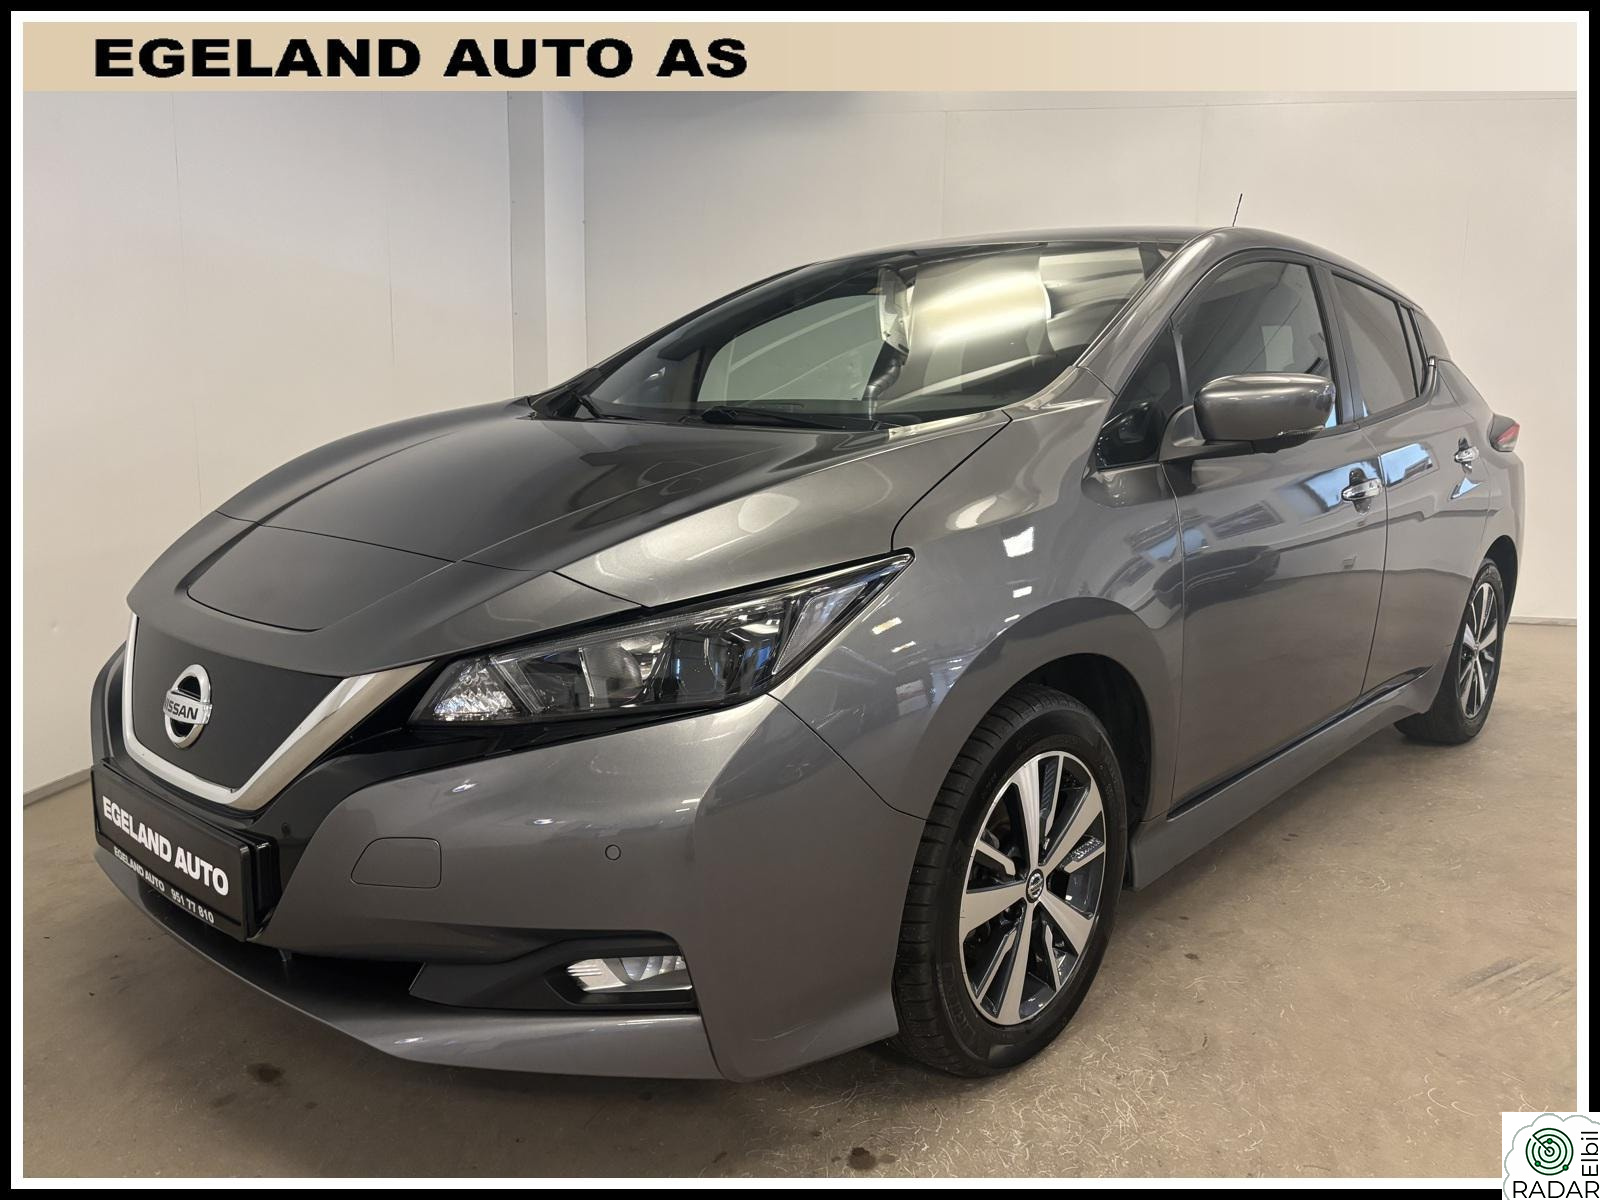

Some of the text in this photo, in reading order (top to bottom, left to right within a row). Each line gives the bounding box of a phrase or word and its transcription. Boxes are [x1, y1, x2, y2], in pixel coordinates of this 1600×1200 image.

[102, 795, 229, 896] EGELAND AUTO
[113, 845, 215, 924] EGELAND AUTO 951 77 810
